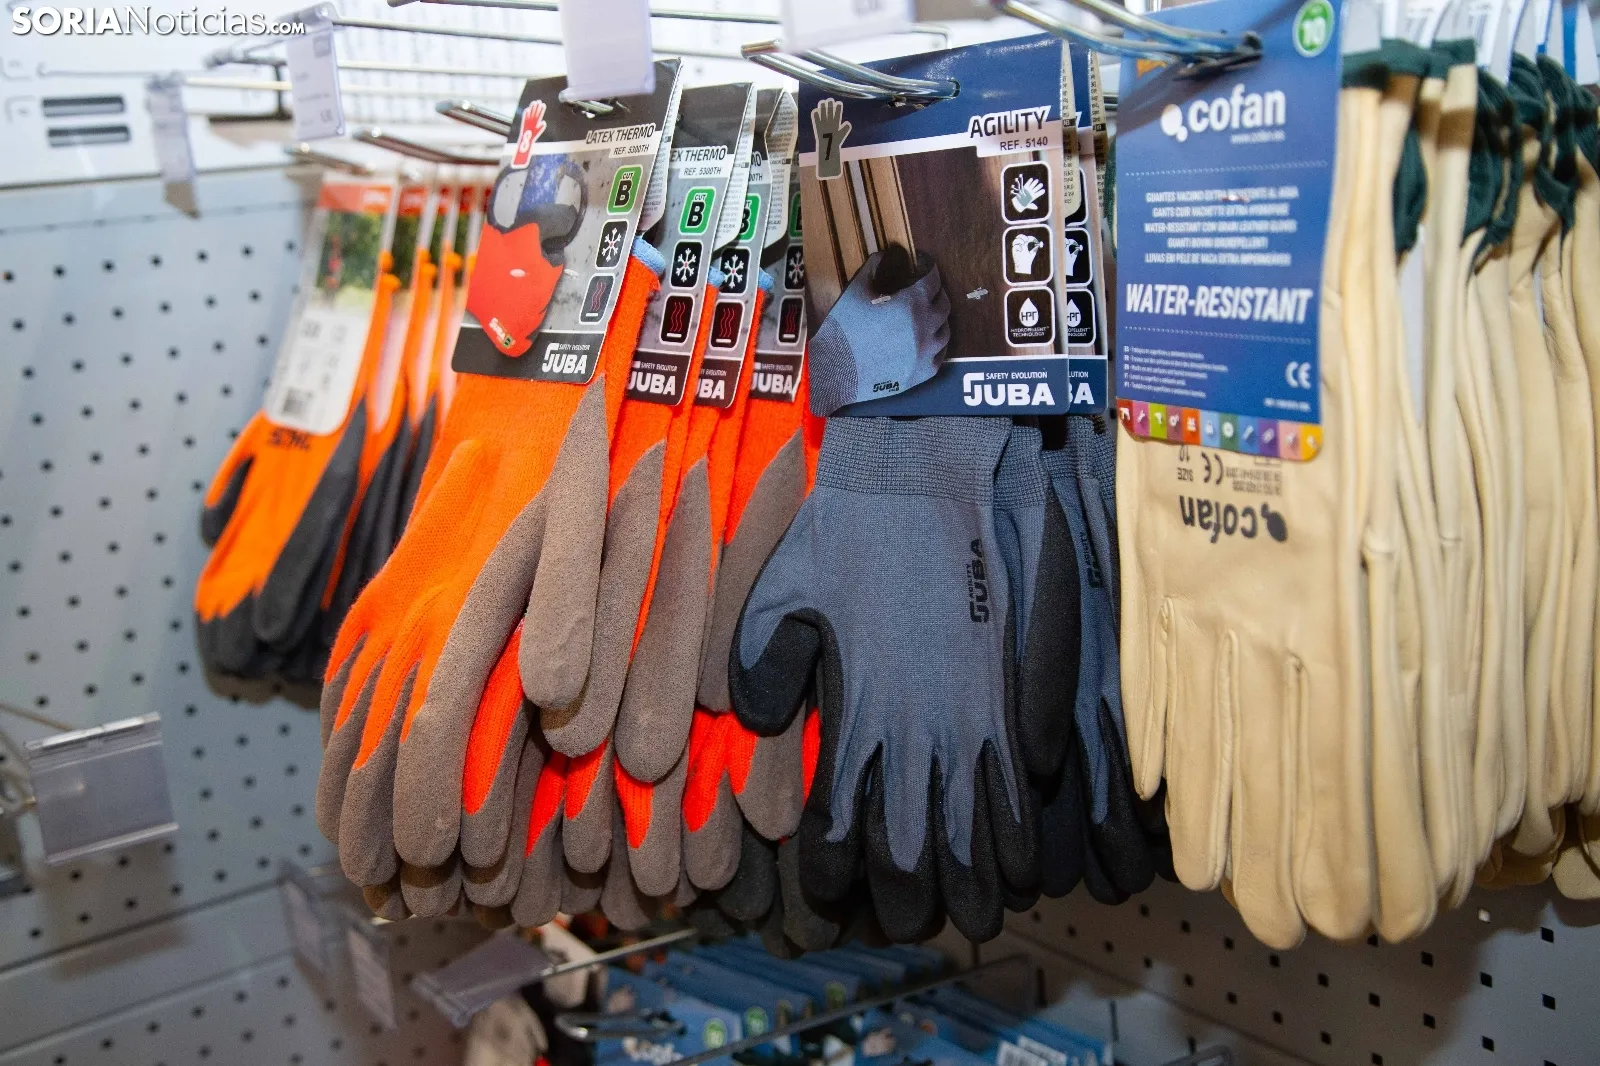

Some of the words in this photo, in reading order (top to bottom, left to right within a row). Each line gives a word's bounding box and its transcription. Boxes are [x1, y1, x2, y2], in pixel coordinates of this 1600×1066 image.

[1188, 83, 1286, 132] cofan
[586, 130, 615, 144] LATEX
[615, 125, 655, 141] THERMO
[970, 110, 1047, 138] AGILITY
[519, 129, 533, 153] 8
[613, 147, 627, 155] REF.
[685, 148, 726, 161] THERMO
[823, 133, 833, 160] 7
[1000, 141, 1023, 152] REF.
[1025, 136, 1048, 148] 5140
[622, 172, 634, 180] CUT
[683, 168, 698, 176] REF.
[700, 167, 722, 175] 5300TH
[614, 179, 632, 206] B
[686, 201, 705, 227] B
[1126, 283, 1314, 324] WATER-RESISTANT
[542, 343, 588, 374] JUBA
[640, 362, 655, 370] SAFETY
[656, 363, 678, 372] EVOLUTION
[628, 363, 676, 396] JUBA
[751, 364, 793, 395] JUBA
[963, 372, 1056, 406] JUBA
[986, 372, 1009, 380] SAFETY
[1011, 371, 1048, 379] EVOLUTION
[1177, 467, 1193, 482] SIZE
[1179, 495, 1257, 544] cofan
[966, 564, 974, 598] AGILITY
[969, 539, 989, 623] JUBA
